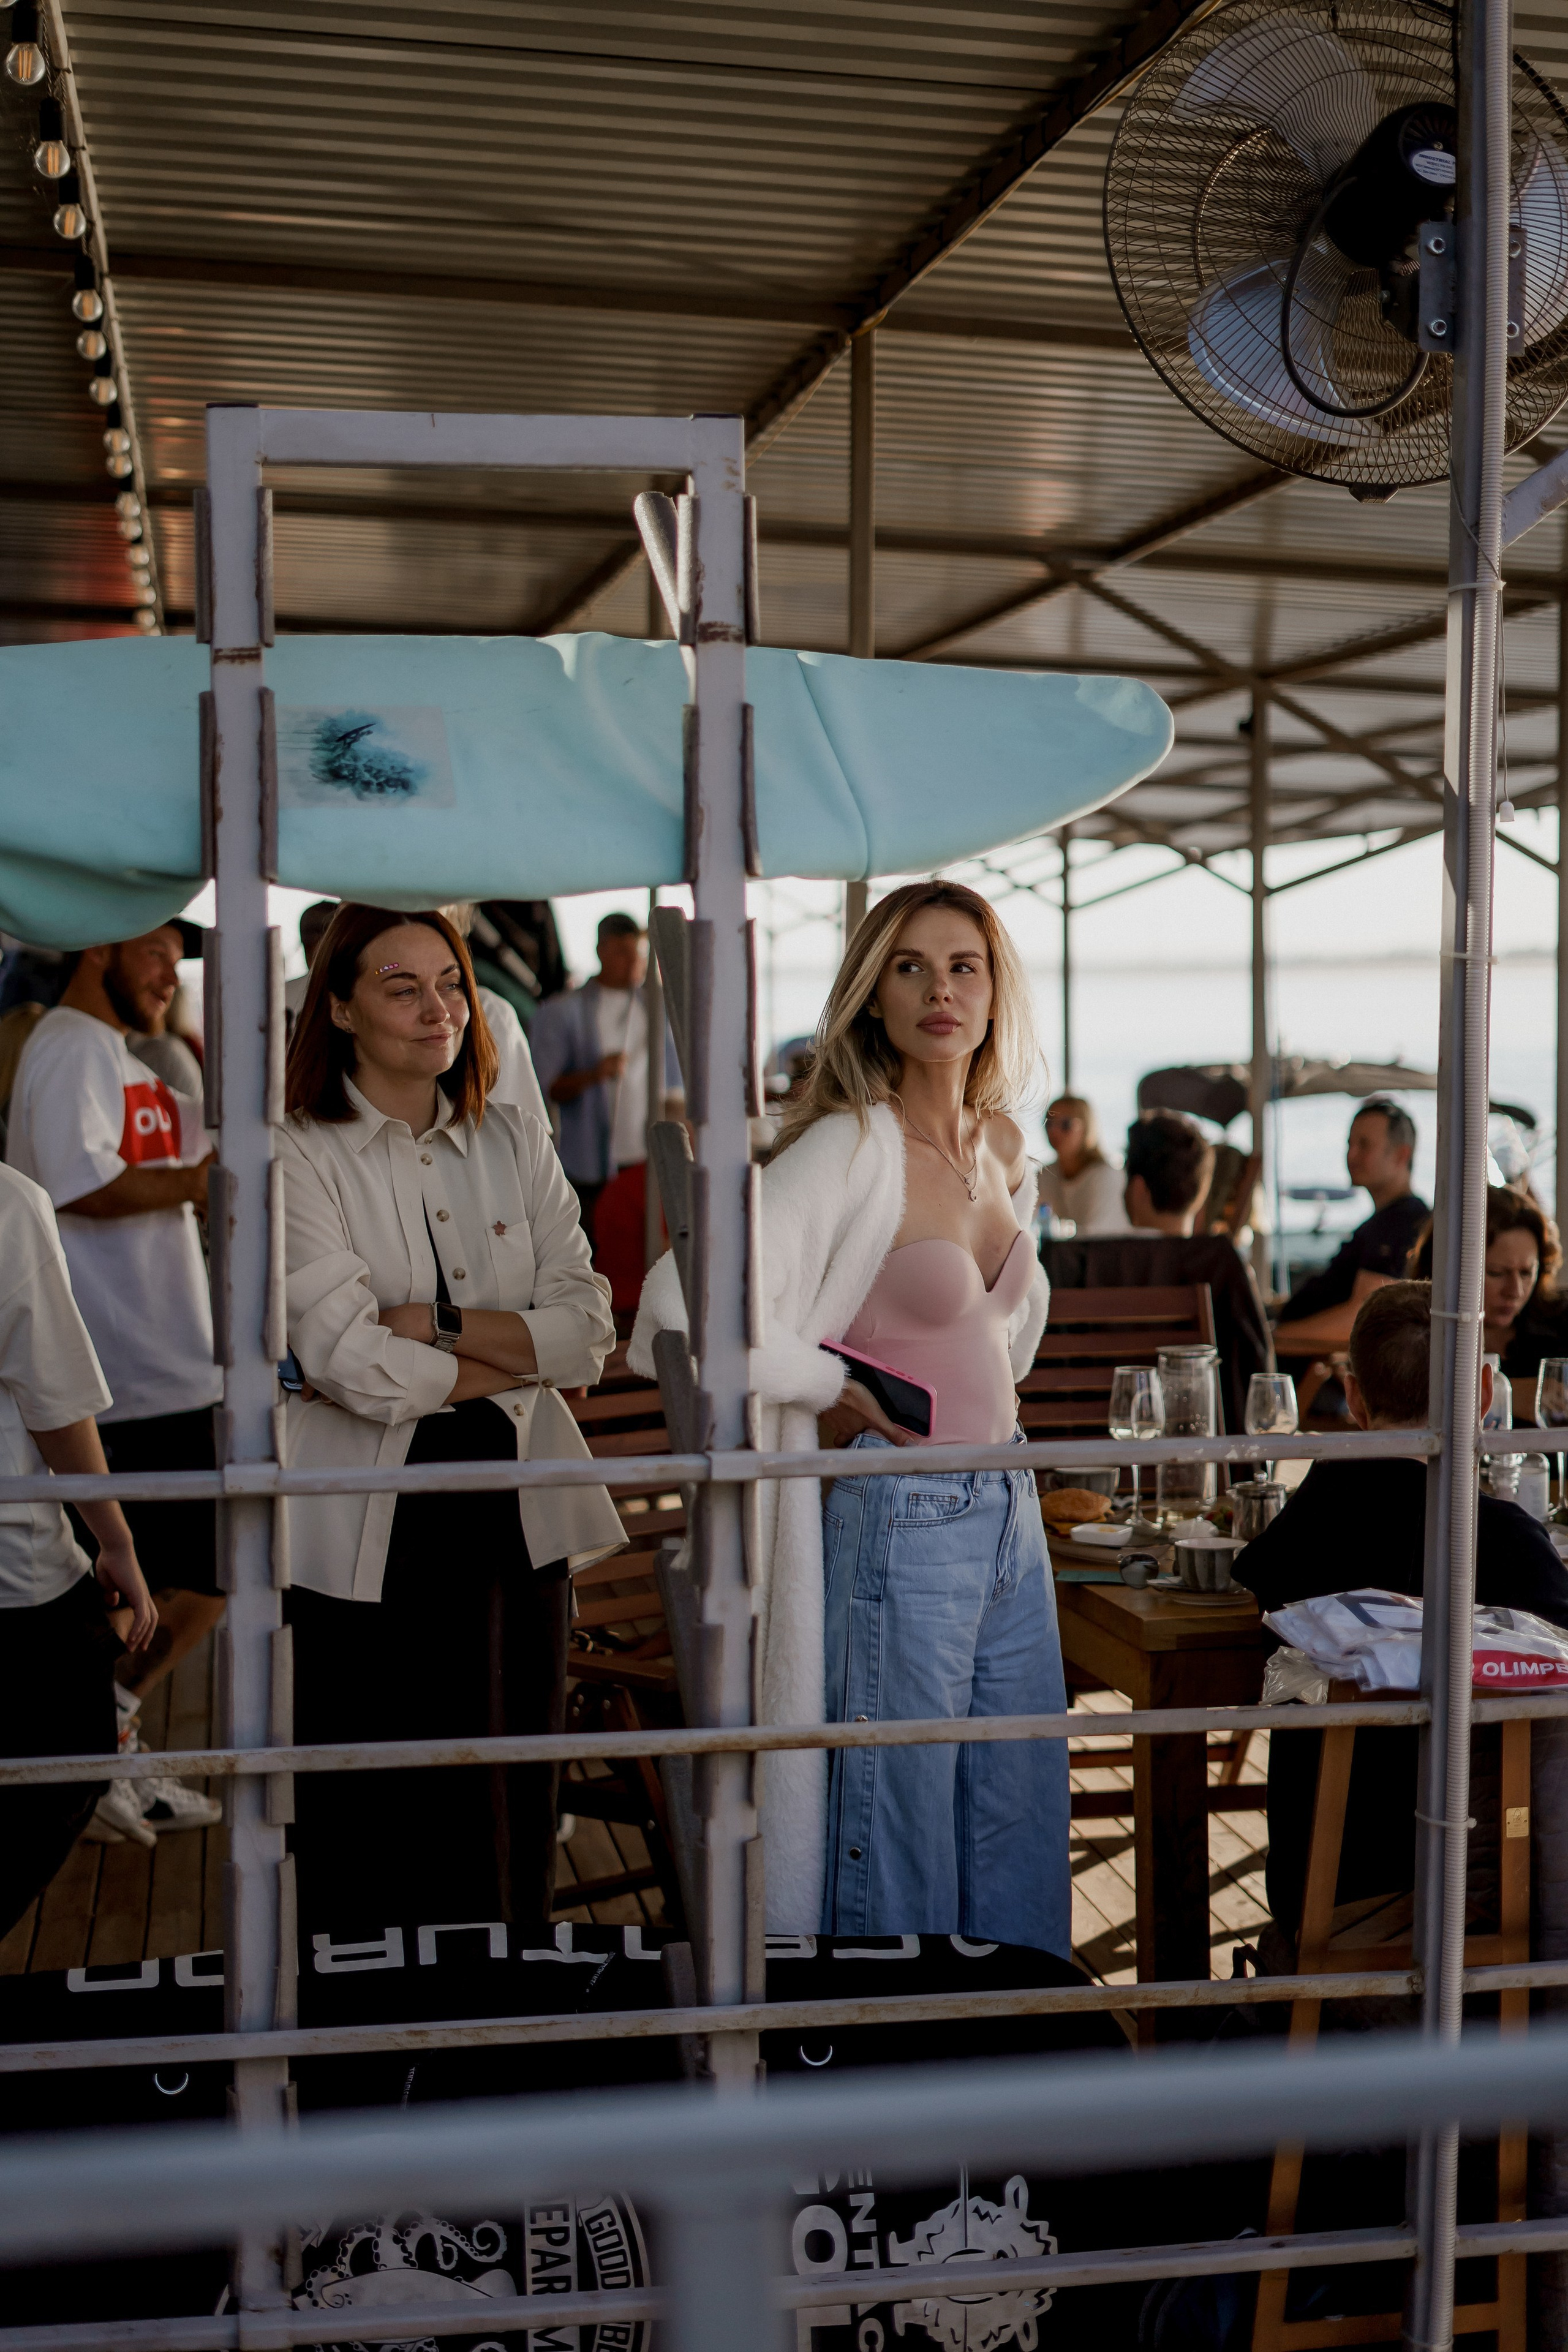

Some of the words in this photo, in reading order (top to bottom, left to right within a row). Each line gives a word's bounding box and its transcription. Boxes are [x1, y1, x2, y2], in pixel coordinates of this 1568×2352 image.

[1419, 153, 1451, 165] INDUSTRIAL
[530, 2204, 575, 2352] EPARM
[585, 2209, 631, 2290] GOOD
